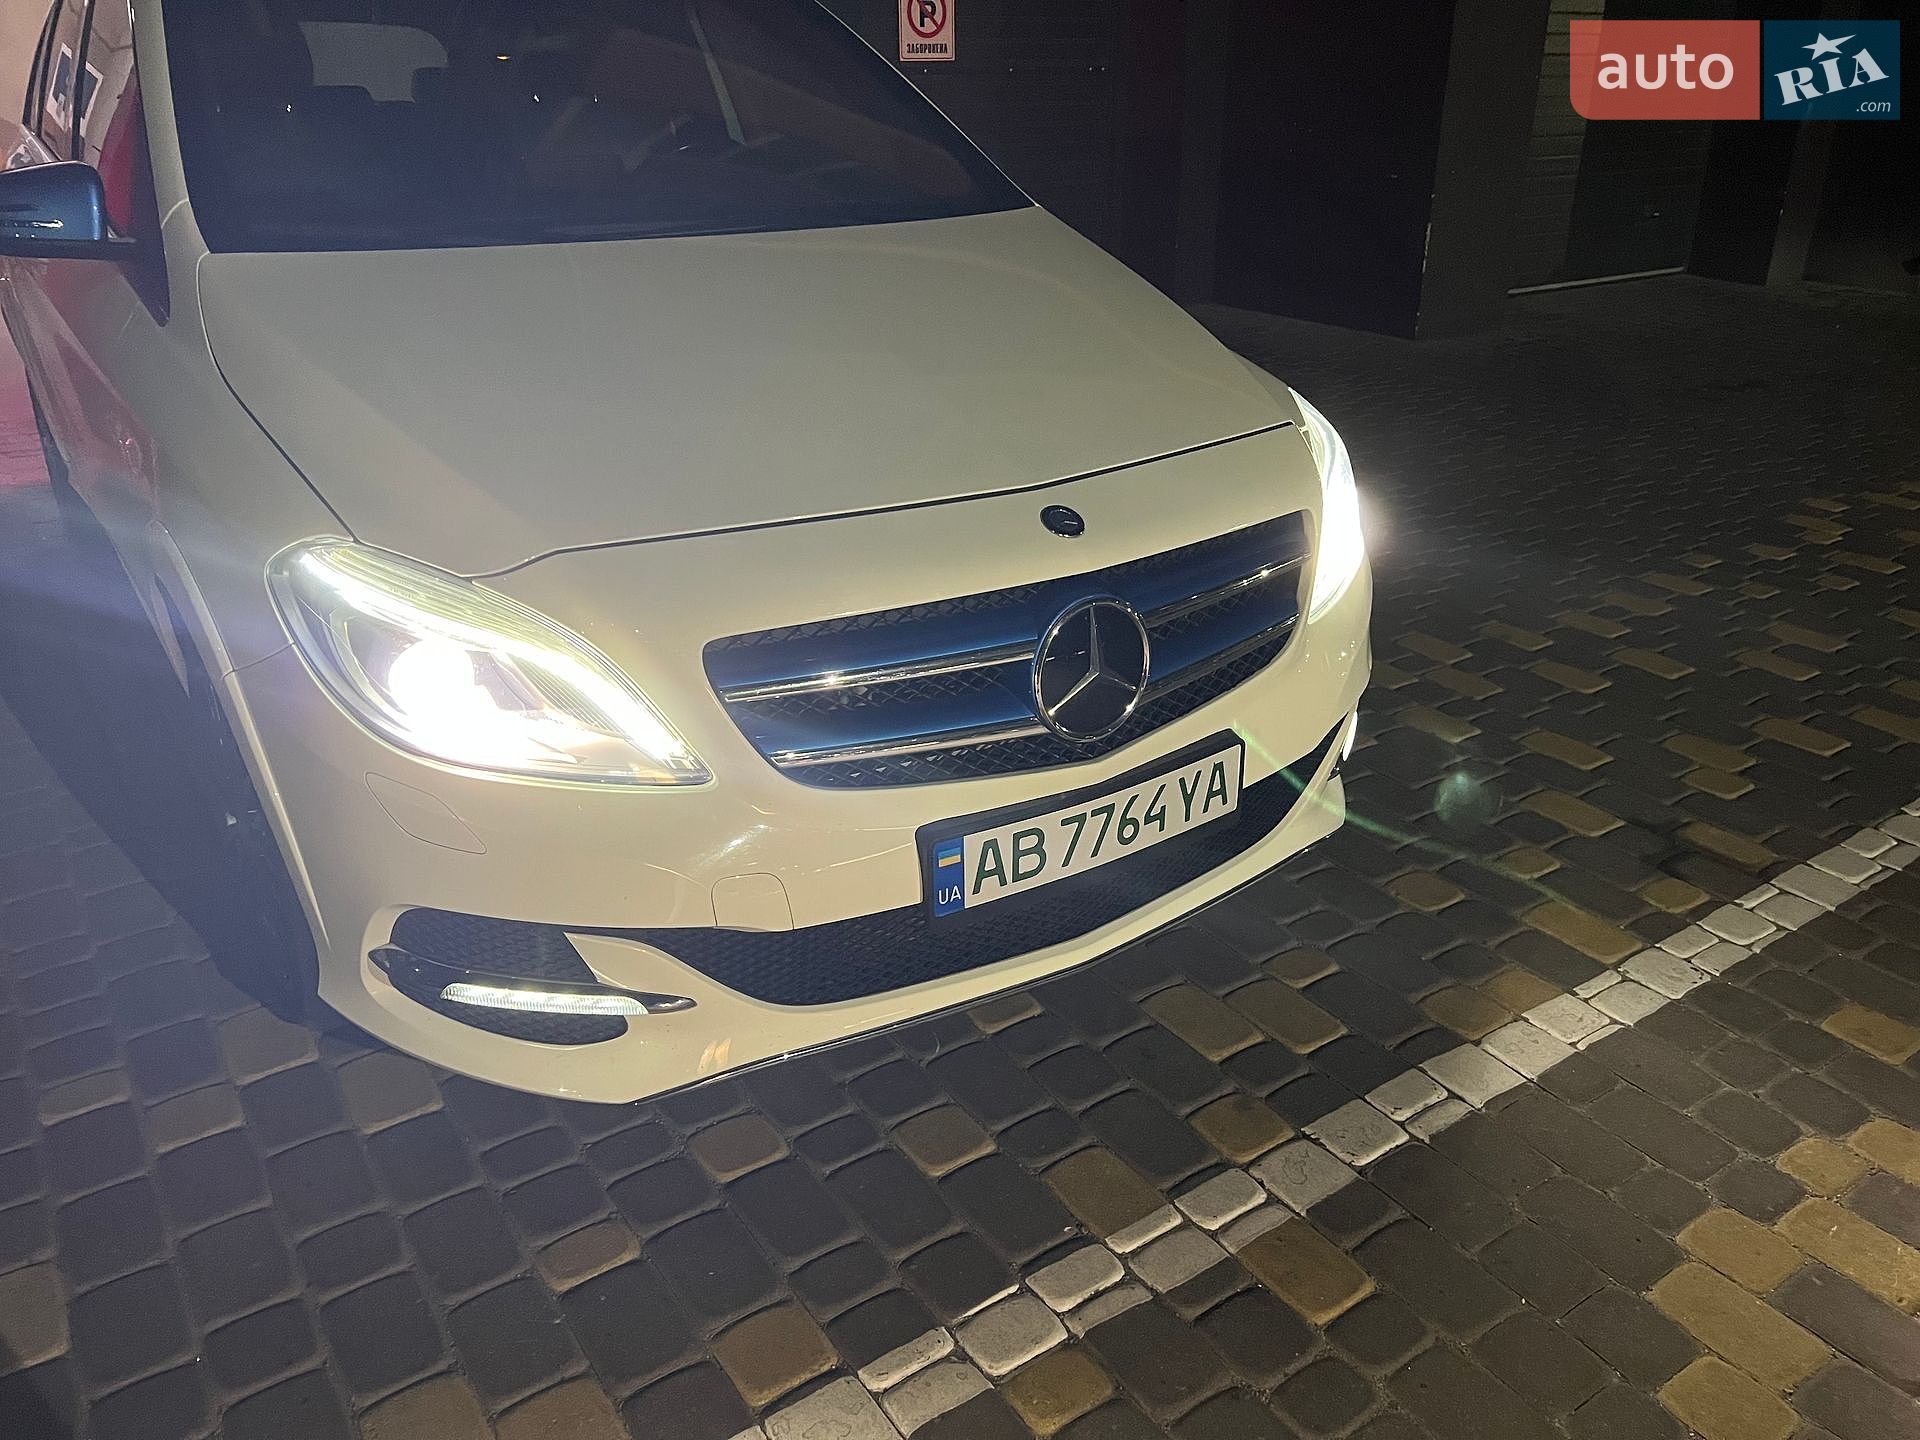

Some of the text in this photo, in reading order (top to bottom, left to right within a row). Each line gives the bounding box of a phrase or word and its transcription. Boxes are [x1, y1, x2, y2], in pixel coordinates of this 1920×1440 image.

[906, 43, 948, 54] ЗАБОРОНЕНА
[972, 761, 1228, 895] AB 7764 YA
[938, 886, 961, 904] UA
